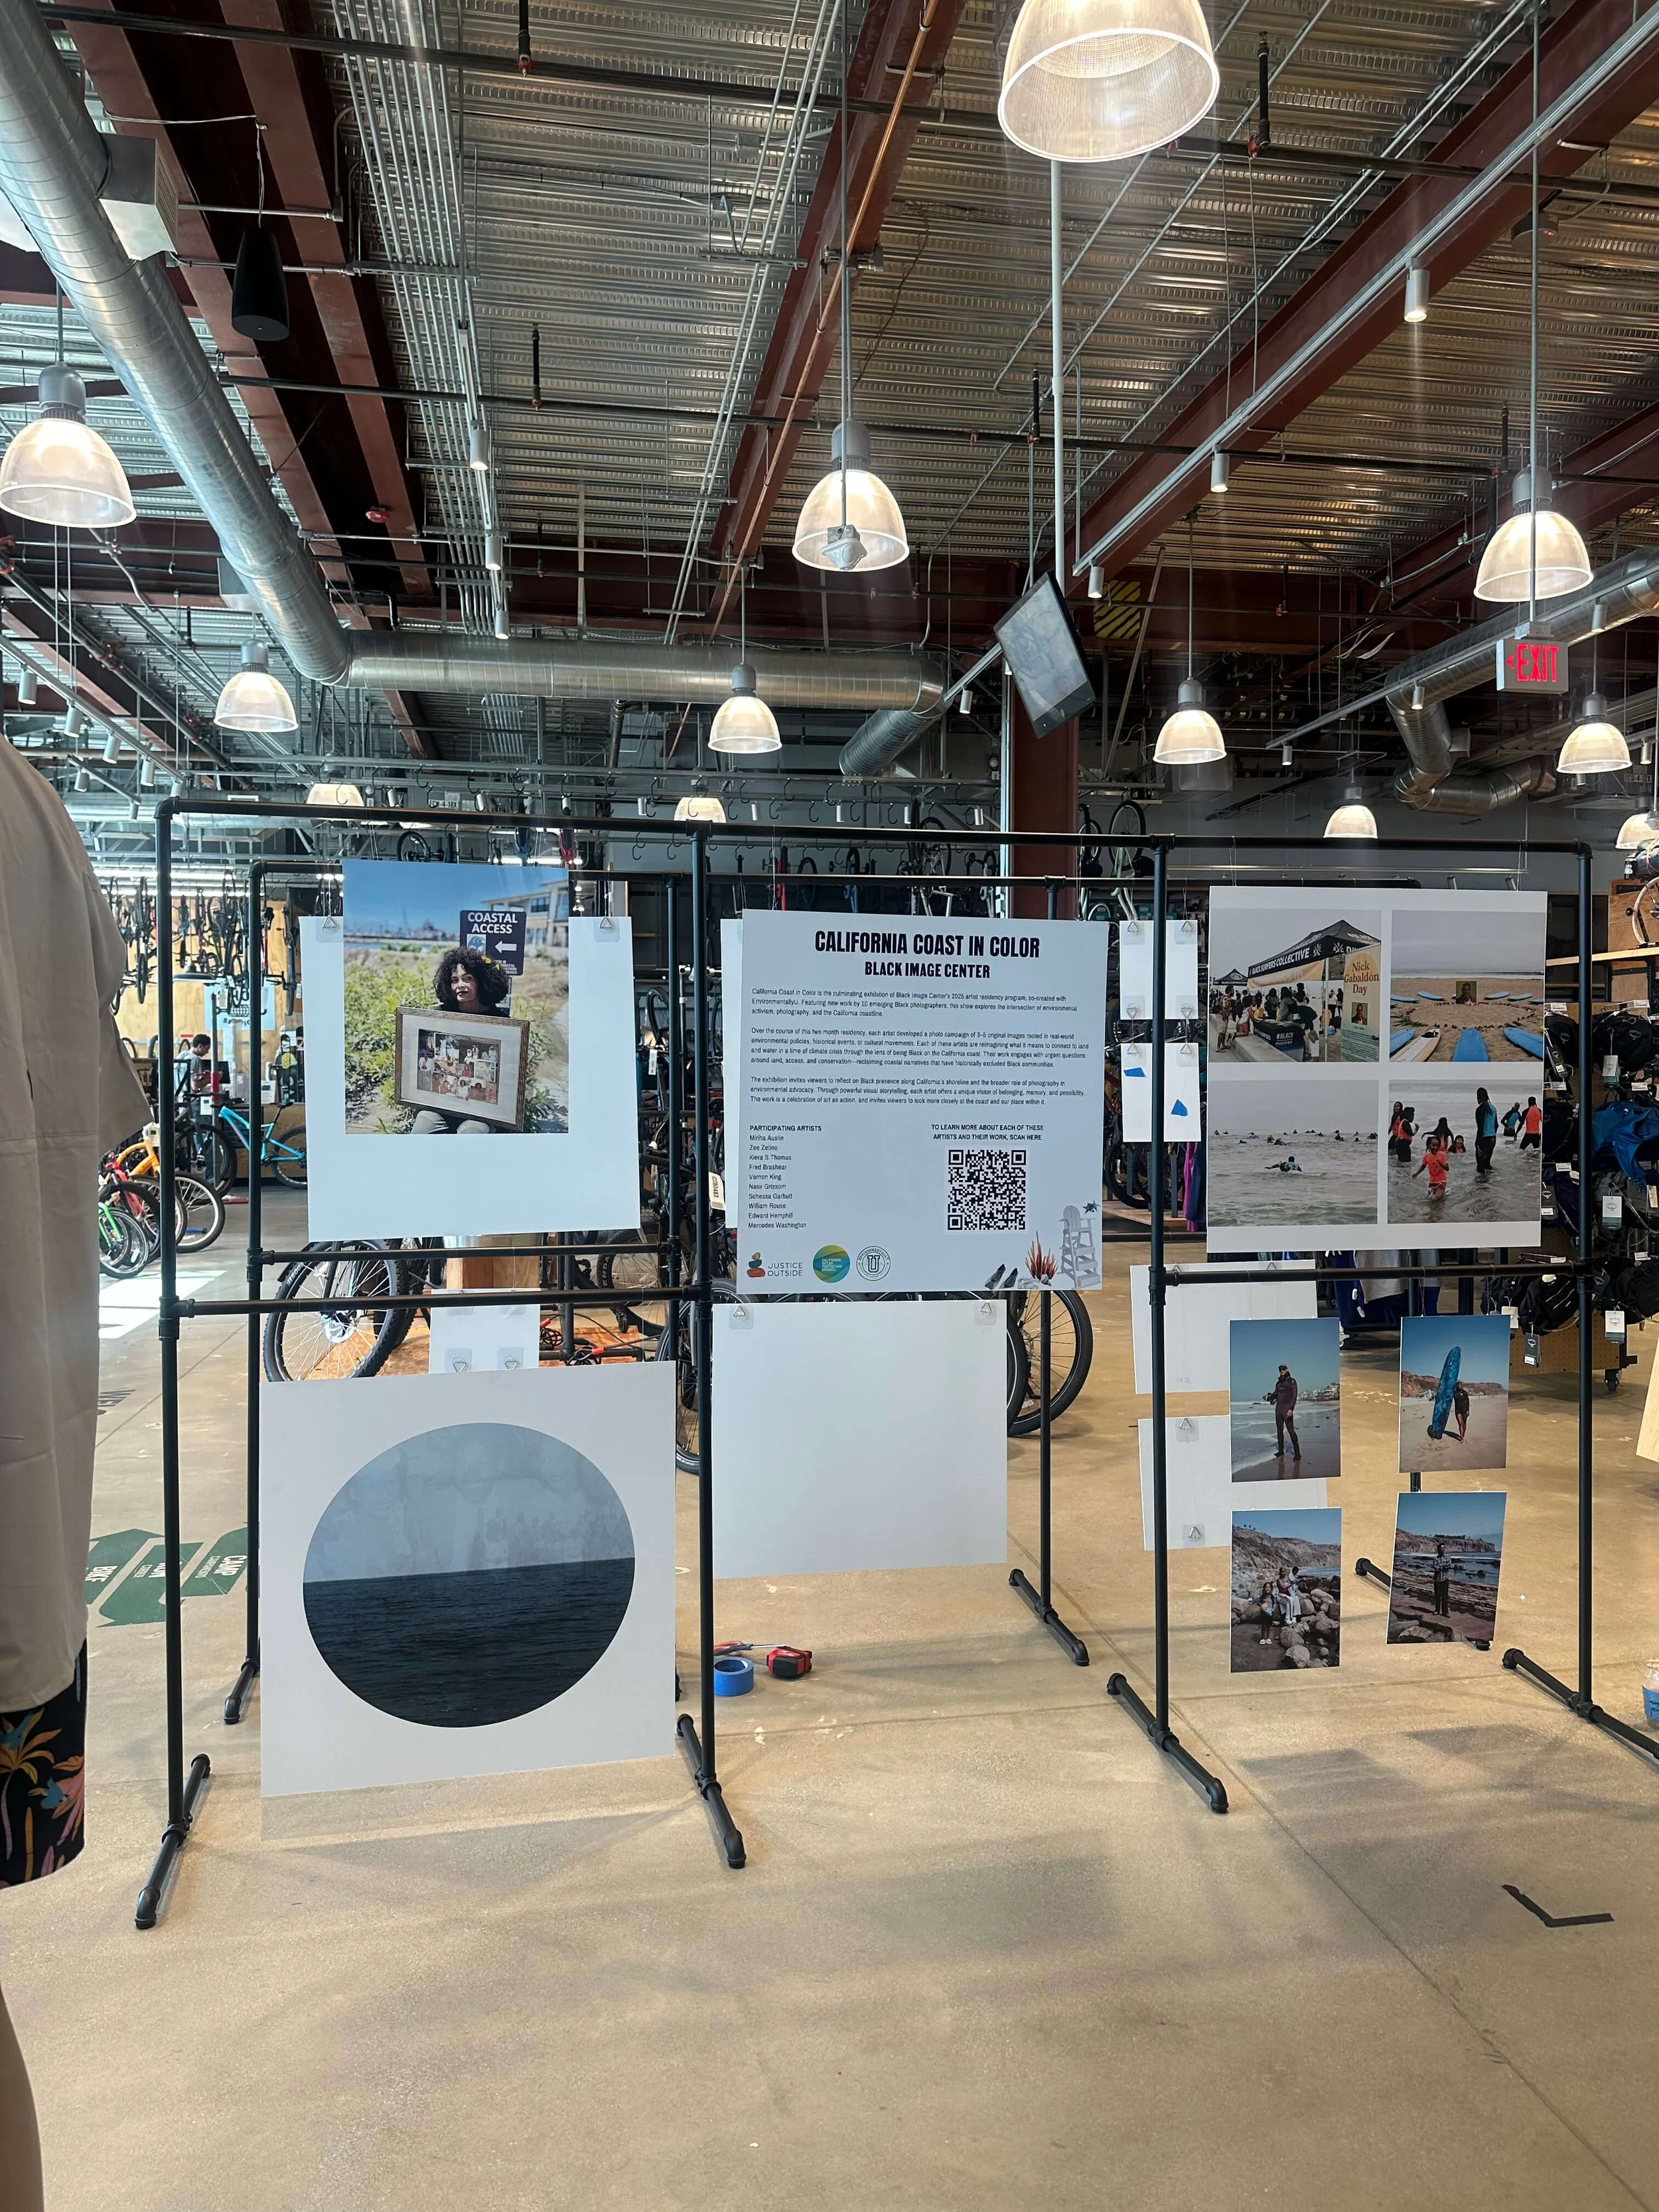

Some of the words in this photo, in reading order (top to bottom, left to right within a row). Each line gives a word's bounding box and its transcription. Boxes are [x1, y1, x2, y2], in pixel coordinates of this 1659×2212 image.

[1517, 643, 1559, 682] EXIT
[467, 912, 518, 923] COASTAL
[471, 923, 513, 934] ACCESS
[815, 930, 908, 954] CALIFORNIA
[913, 934, 964, 956] COAST
[969, 935, 984, 956] IN
[989, 936, 1040, 958] COLOR
[1275, 947, 1311, 968] COLLECTIVE
[865, 961, 902, 976] BLACK
[905, 962, 941, 977] IMAGE
[944, 964, 990, 978] CENTER
[1352, 960, 1370, 972] Nick
[1344, 972, 1380, 983] Gabaldón
[833, 990, 863, 998] culminating
[979, 993, 1004, 1001] residency
[1352, 984, 1368, 995] Day
[867, 1255, 881, 1272] U
[213, 1555, 248, 1576] CAMP
[85, 1566, 118, 1582] BIKE
